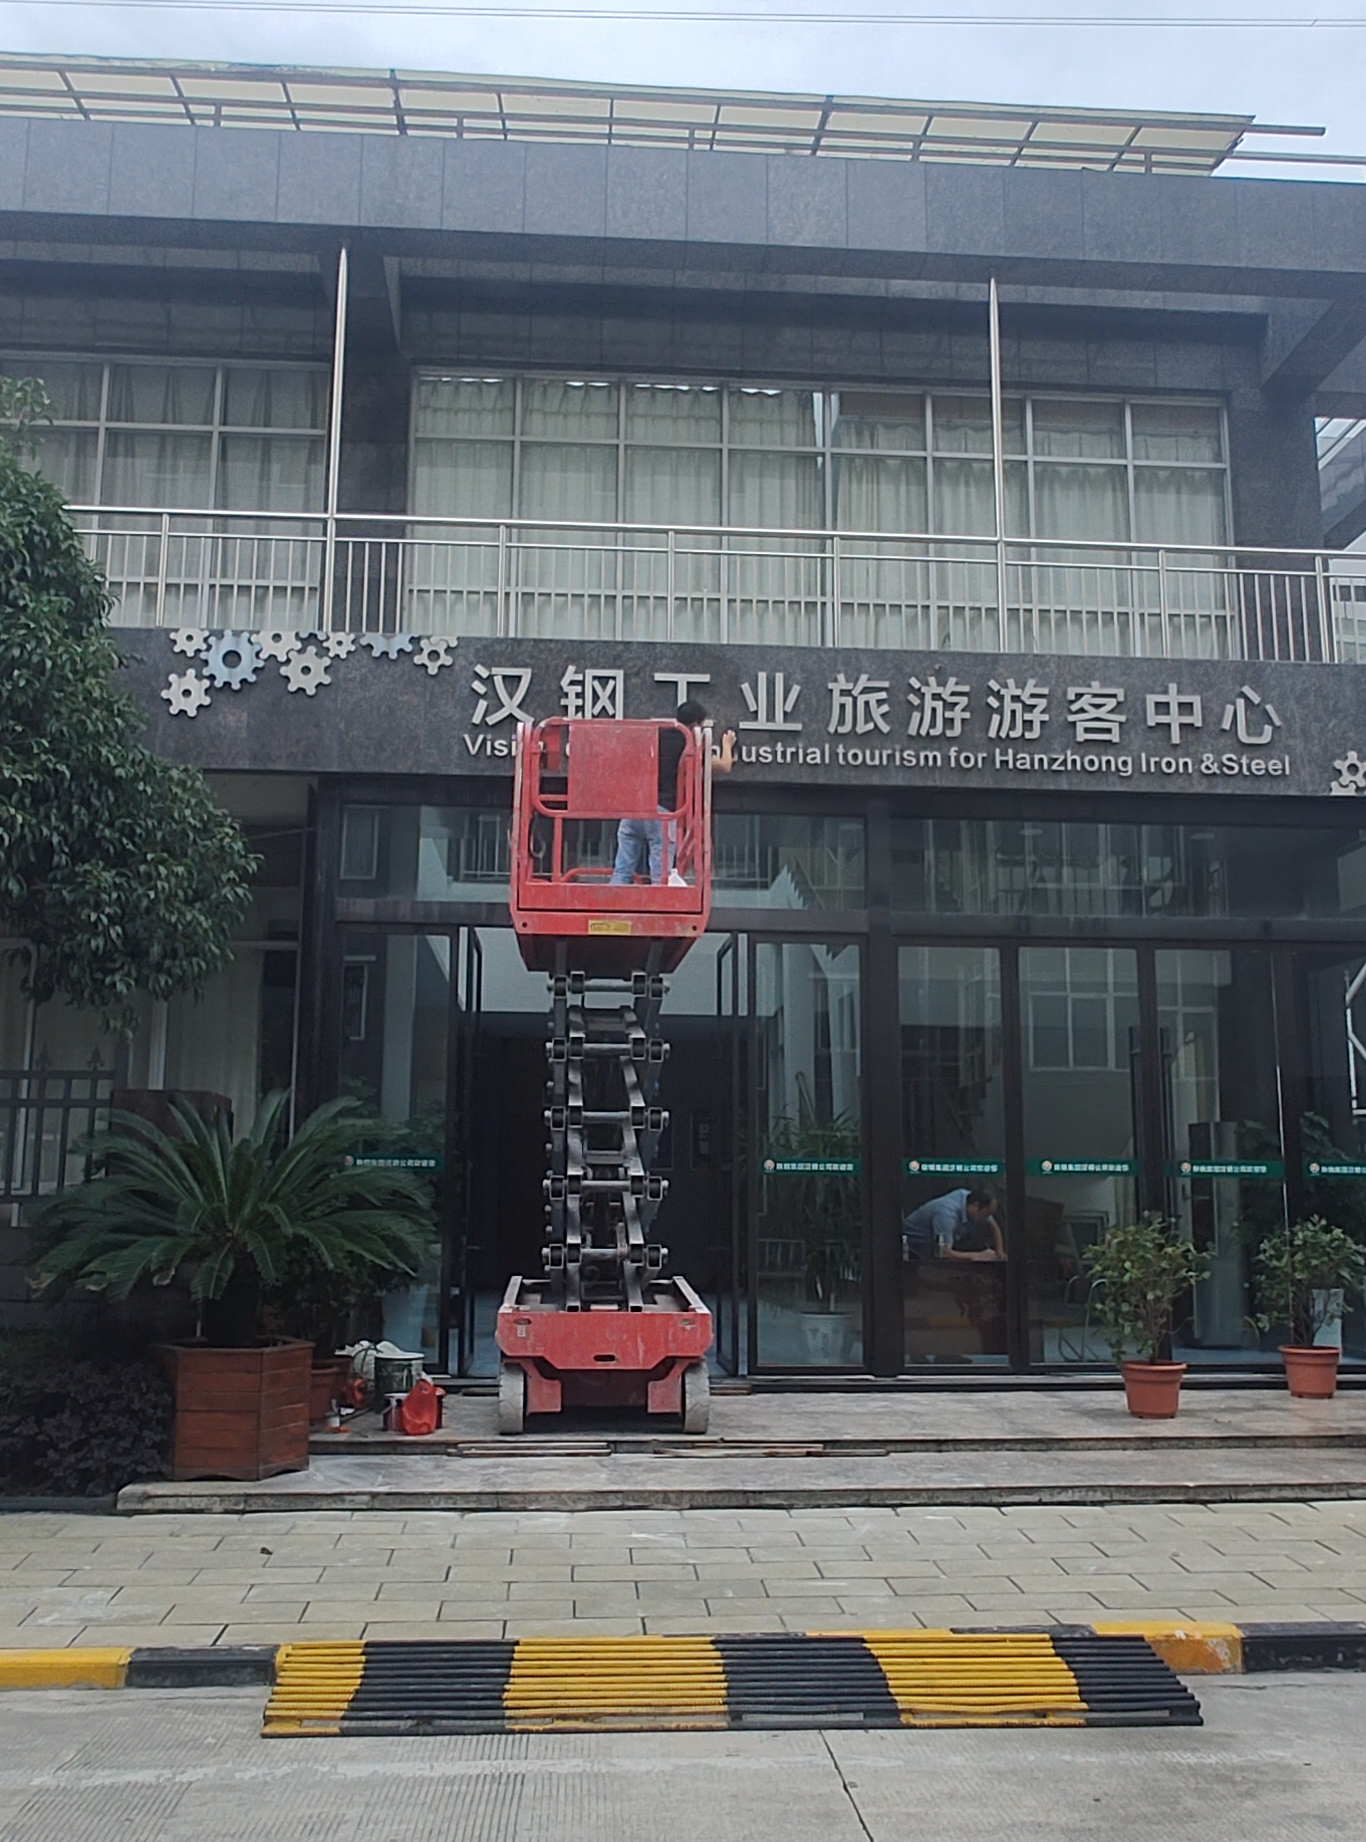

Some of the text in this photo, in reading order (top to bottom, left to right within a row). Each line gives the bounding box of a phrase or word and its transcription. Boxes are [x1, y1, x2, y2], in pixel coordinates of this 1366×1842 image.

[471, 664, 1282, 745] 汉钢工业旅游游客中心
[837, 743, 942, 768] tourism
[949, 746, 987, 769] for
[995, 748, 1132, 777] Hanzhong
[1141, 752, 1193, 774] Iron
